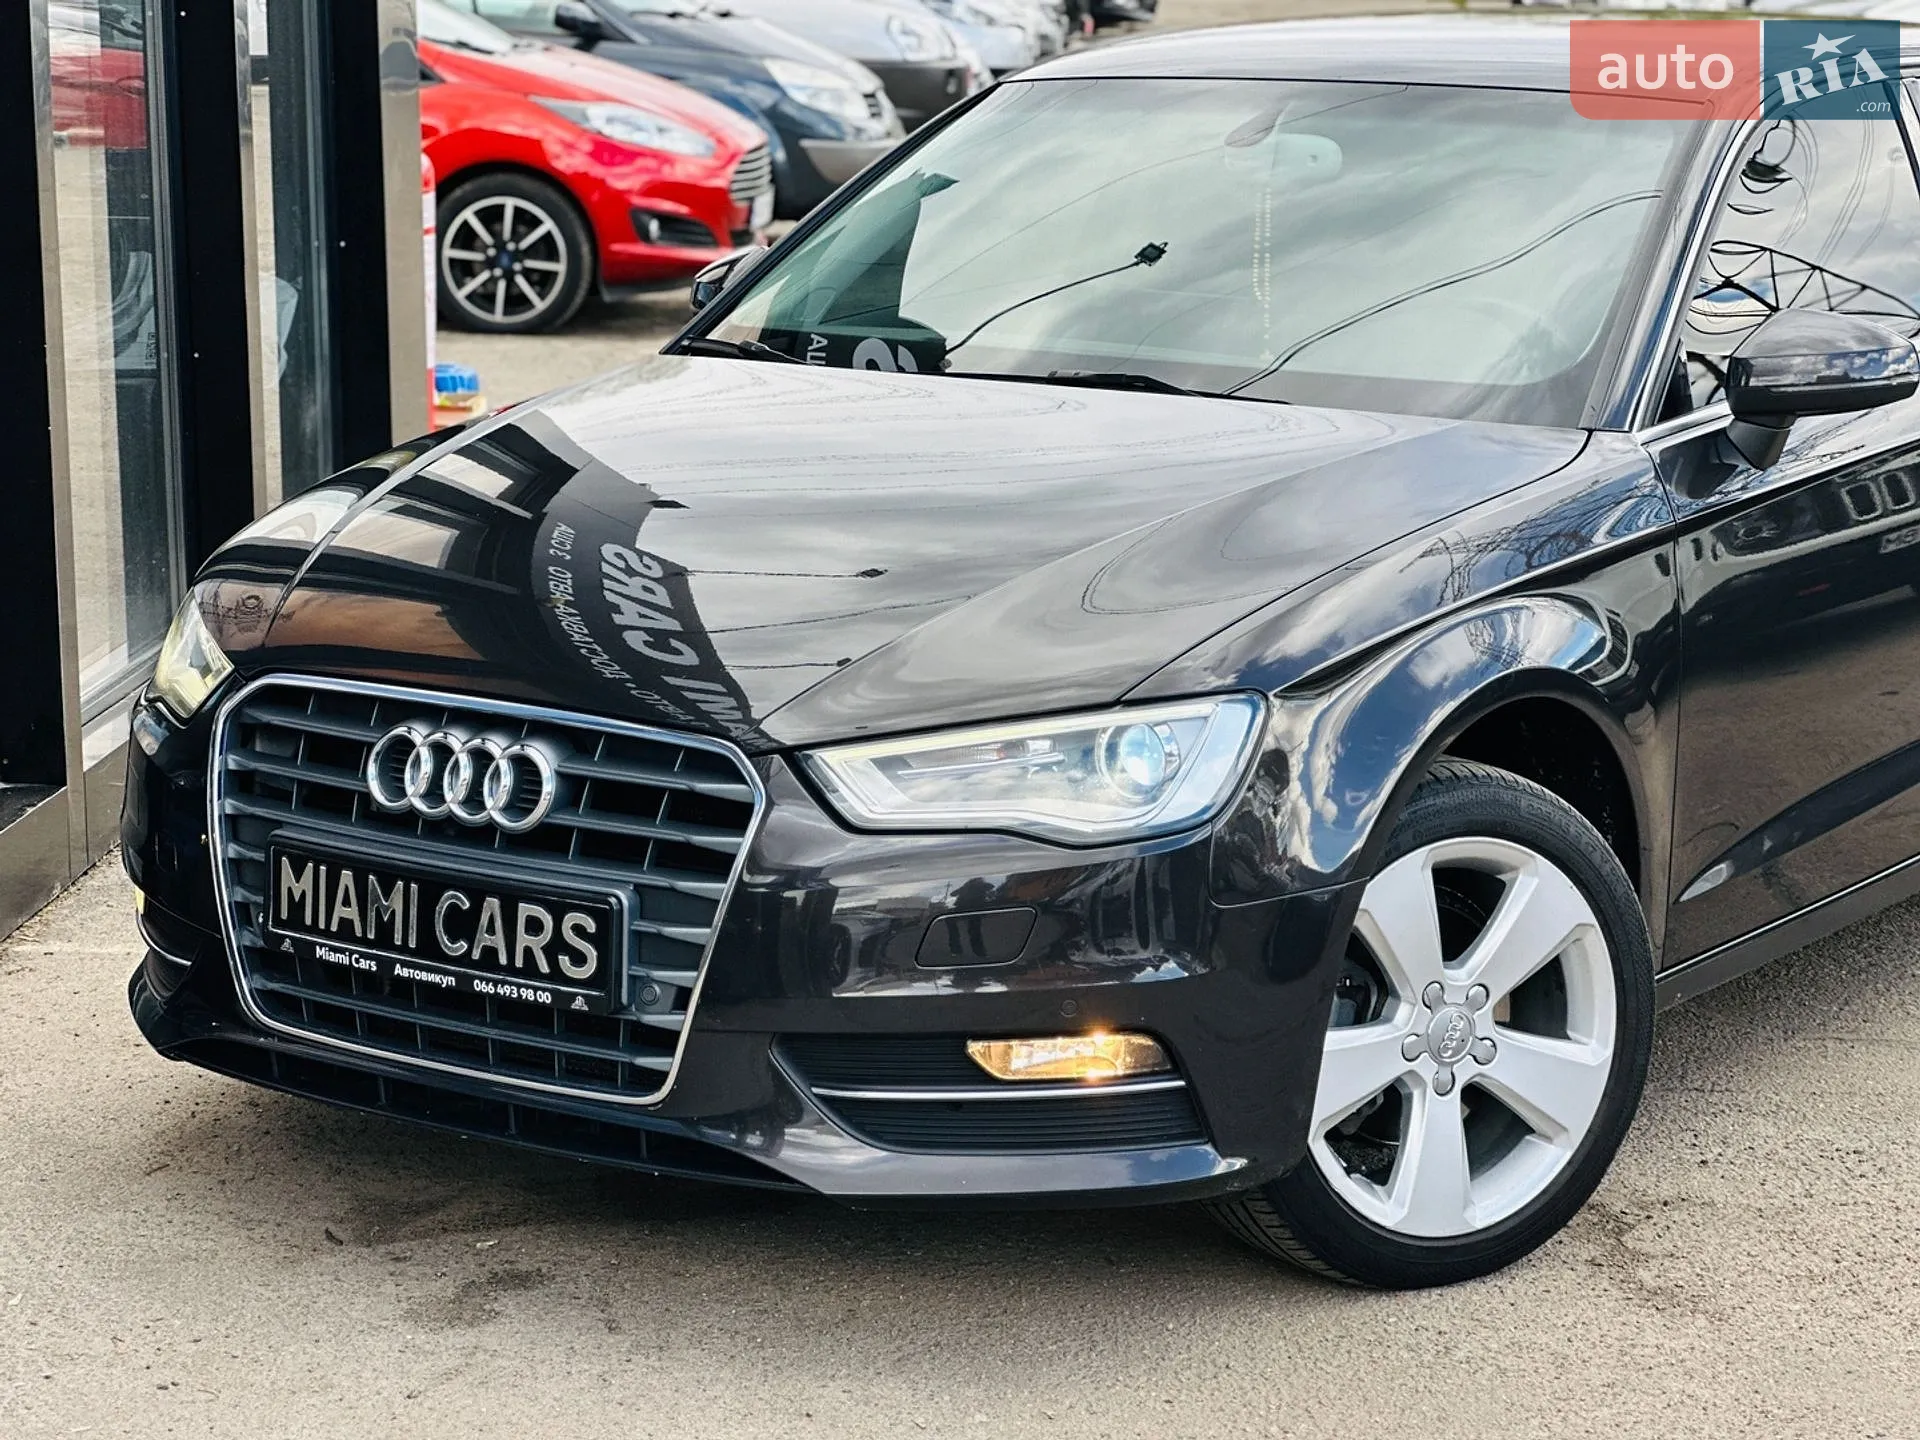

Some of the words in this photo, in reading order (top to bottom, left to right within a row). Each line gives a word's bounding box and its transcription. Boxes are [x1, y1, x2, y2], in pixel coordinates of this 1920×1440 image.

[280, 856, 419, 948] MIAMI
[434, 890, 598, 979] CARS
[315, 946, 350, 966] Miami
[352, 953, 377, 971] Cars
[394, 963, 456, 988] Автовикуп
[473, 980, 495, 993] 066
[497, 985, 518, 998] 493
[519, 988, 535, 1001] 98
[536, 990, 552, 1003] 00
